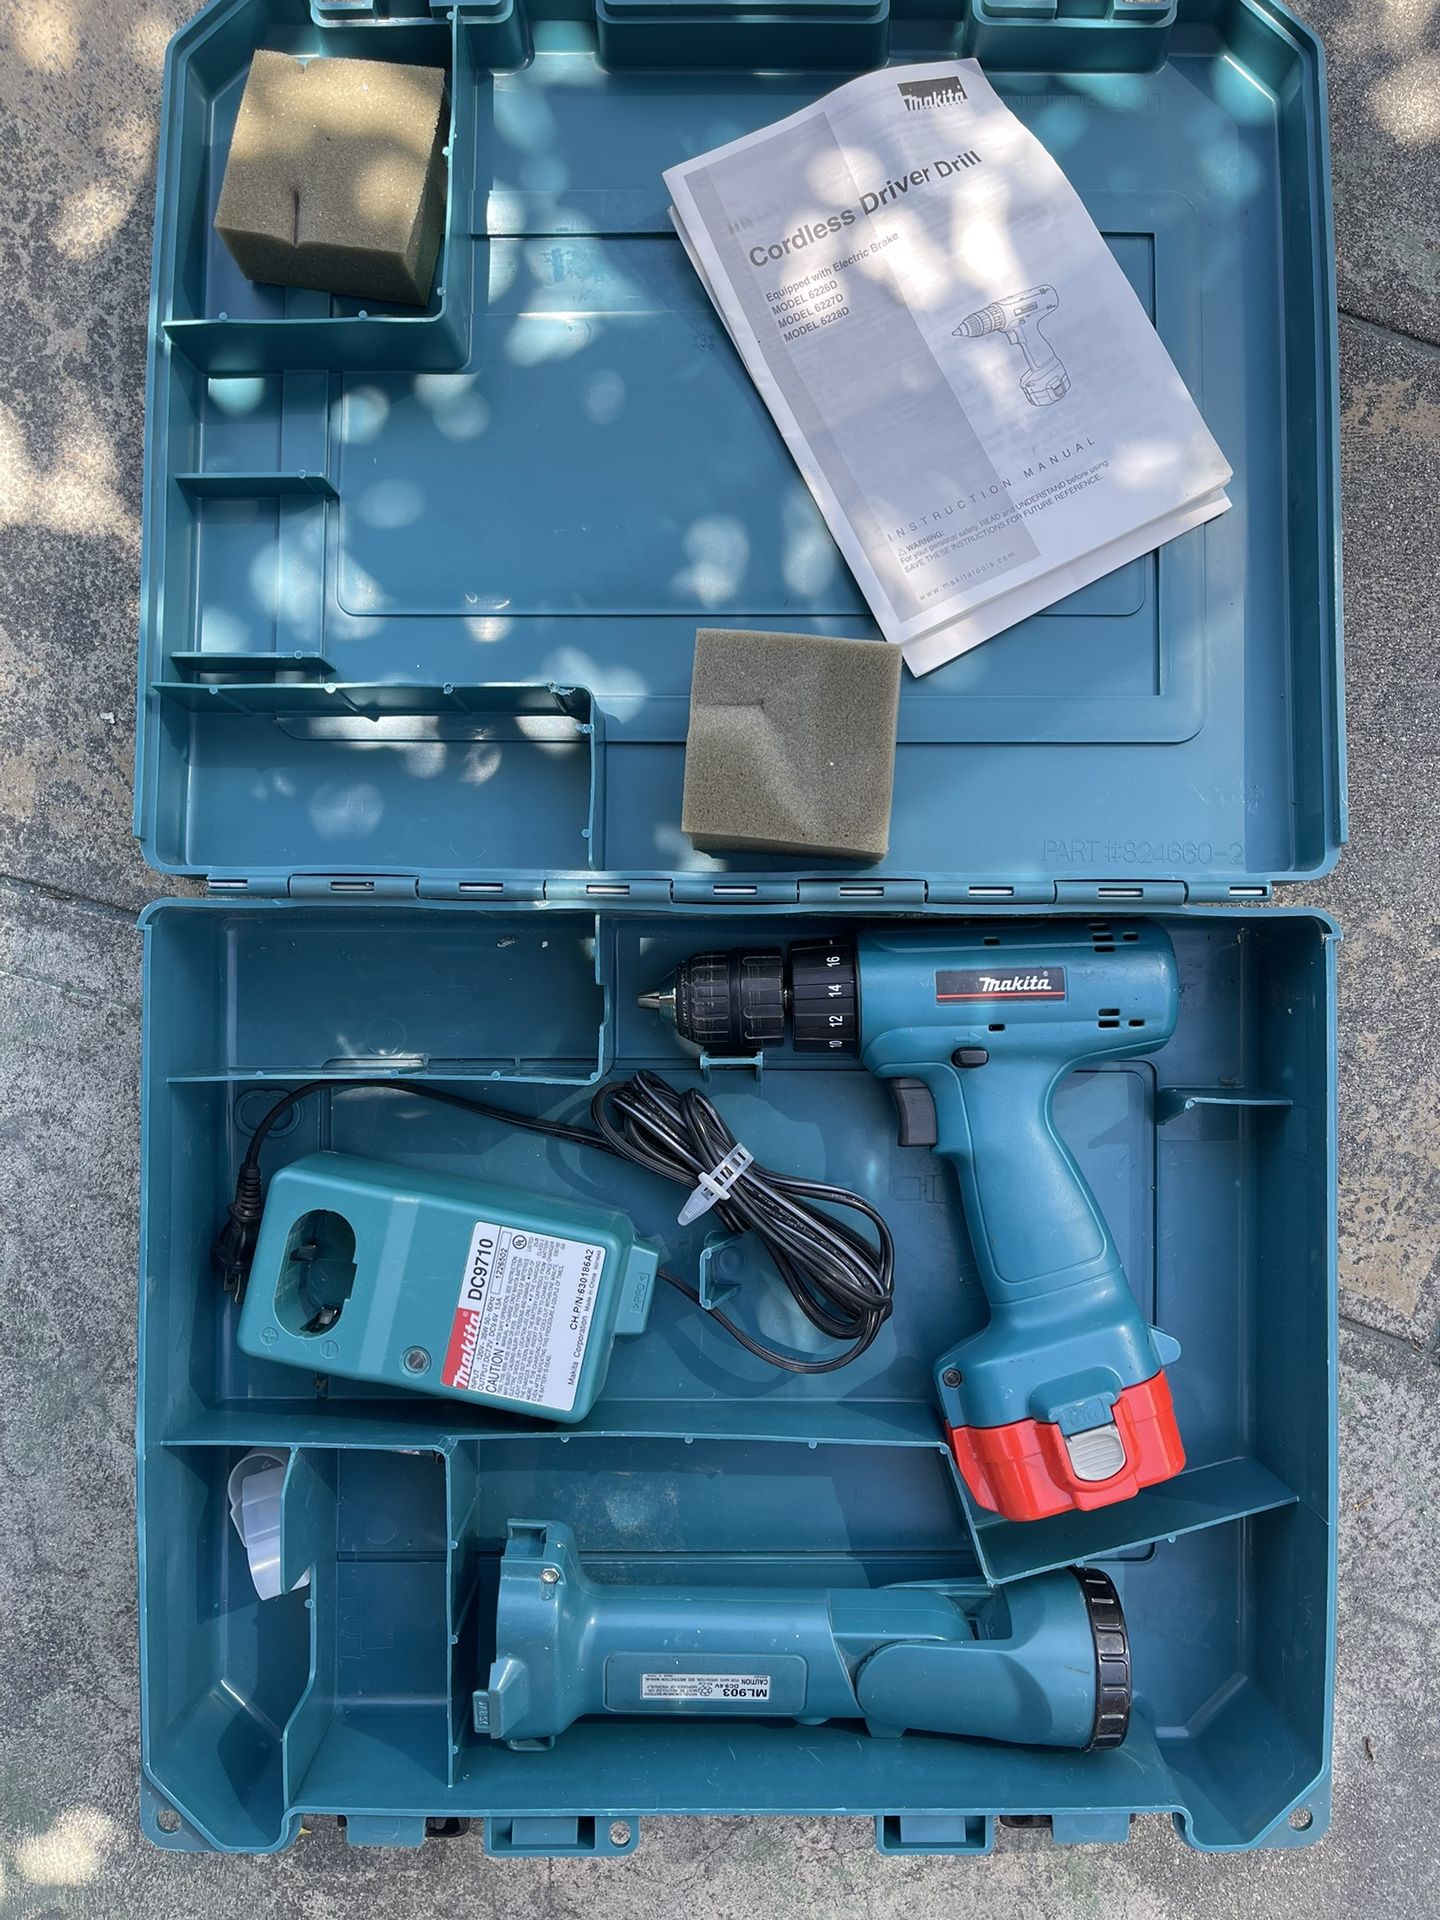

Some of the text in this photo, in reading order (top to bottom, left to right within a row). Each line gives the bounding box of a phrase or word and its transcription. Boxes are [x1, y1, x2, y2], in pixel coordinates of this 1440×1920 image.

[746, 205, 857, 268] Cordless
[857, 165, 934, 214] Driver
[933, 144, 982, 179] Drill
[765, 231, 900, 304] Equipped with Electric Brake
[771, 279, 838, 315] MODEL 6226D
[777, 293, 844, 329] MODEL 6227D
[783, 306, 850, 342] MODEL 6228D
[887, 436, 1096, 542] INSTRUCTION MANUAL
[899, 553, 913, 564] For
[913, 547, 930, 559] your
[928, 533, 958, 552] personal
[979, 512, 1001, 527] READ
[1000, 505, 1015, 517] and
[1014, 480, 1067, 510] UNDERSTAND
[1066, 469, 1089, 485] before
[904, 558, 925, 573] SAVE
[924, 546, 951, 563] THESE
[950, 520, 1005, 551] INSTRUCTIONS
[1005, 512, 1023, 525] FOR
[1022, 496, 1055, 517] FUTURE
[905, 529, 944, 552] WARNING:
[1042, 839, 1099, 863] PART
[826, 956, 841, 968] 16
[828, 984, 842, 998] 14
[829, 1015, 843, 1028] 12
[467, 1237, 493, 1300] DC9710
[568, 1361, 578, 1385] Makita
[573, 1315, 589, 1358] Corporation
[588, 1272, 596, 1288] China
[469, 1369, 479, 1389] INPUT
[484, 1348, 504, 1393] CAUTION
[723, 1689, 767, 1697] ML903
